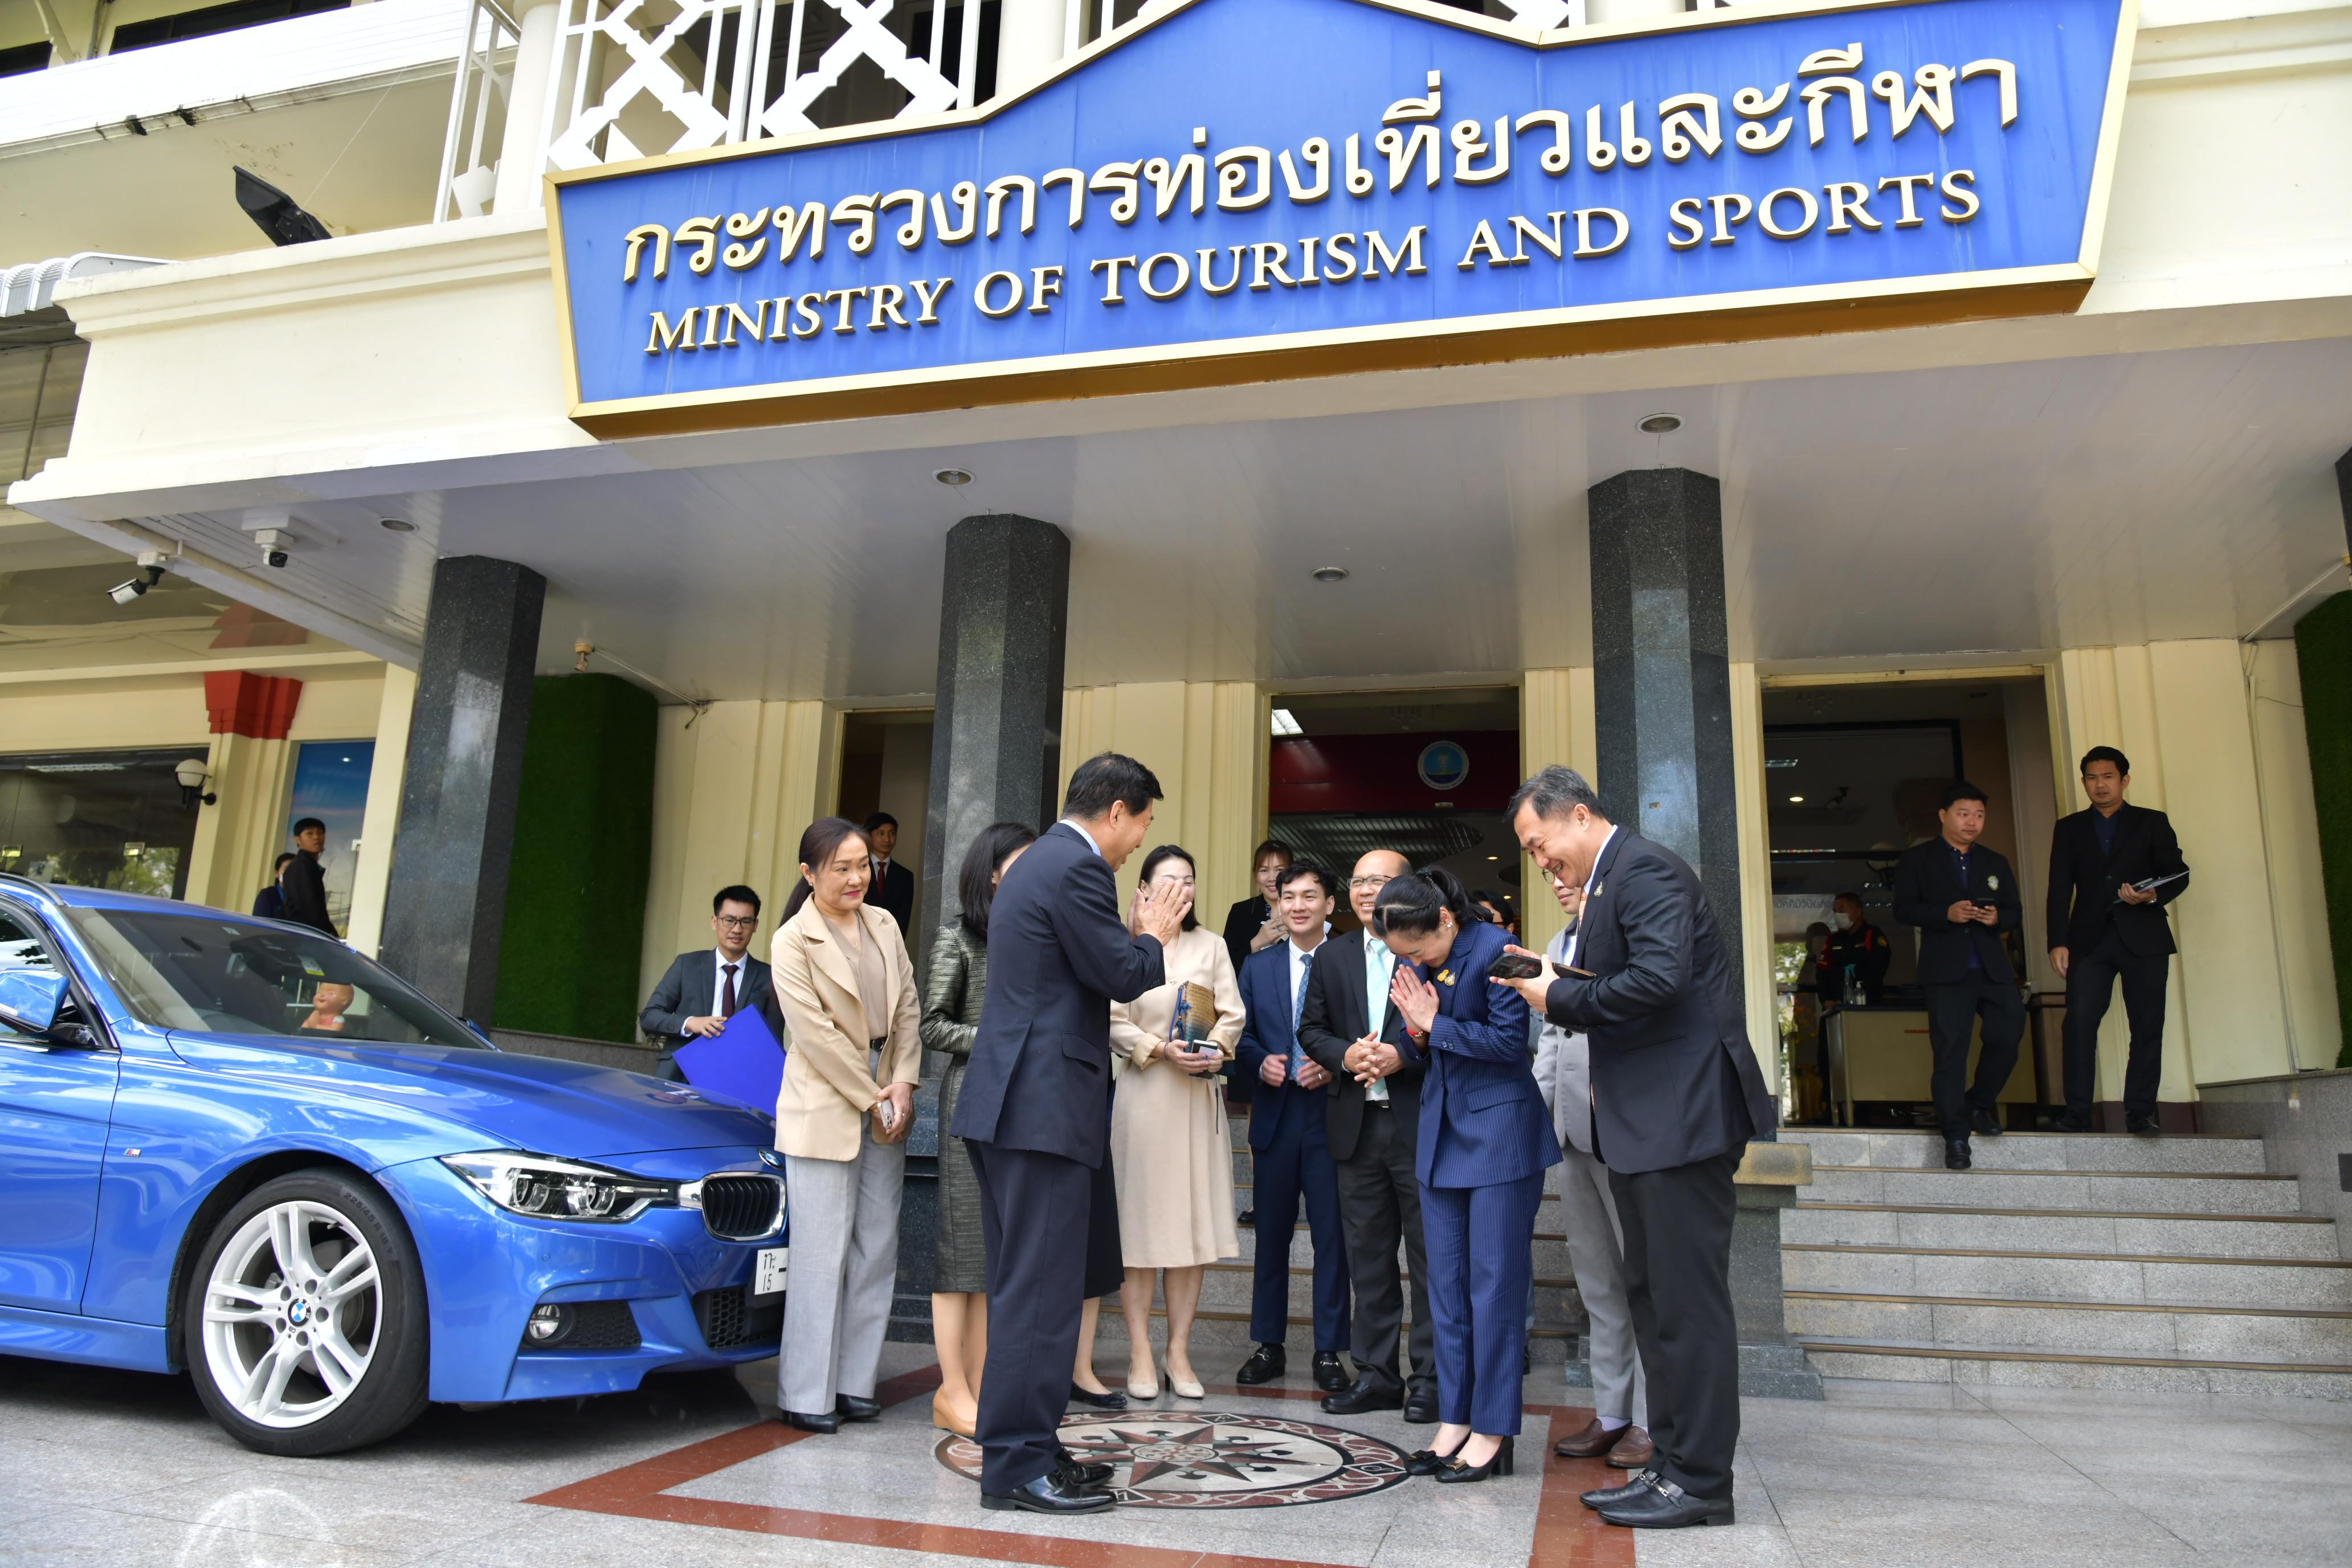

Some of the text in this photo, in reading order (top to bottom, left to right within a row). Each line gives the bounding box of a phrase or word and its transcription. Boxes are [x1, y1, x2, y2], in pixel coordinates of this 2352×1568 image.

[623, 42, 2018, 284] กระทรวงการท่องเที่ยวและกีฬา
[644, 169, 1979, 354] MINISTRY OF TOURISM AND SPORTS
[344, 1193, 375, 1222] 225/45
[381, 1232, 389, 1244] 18
[763, 1273, 772, 1292] 15
